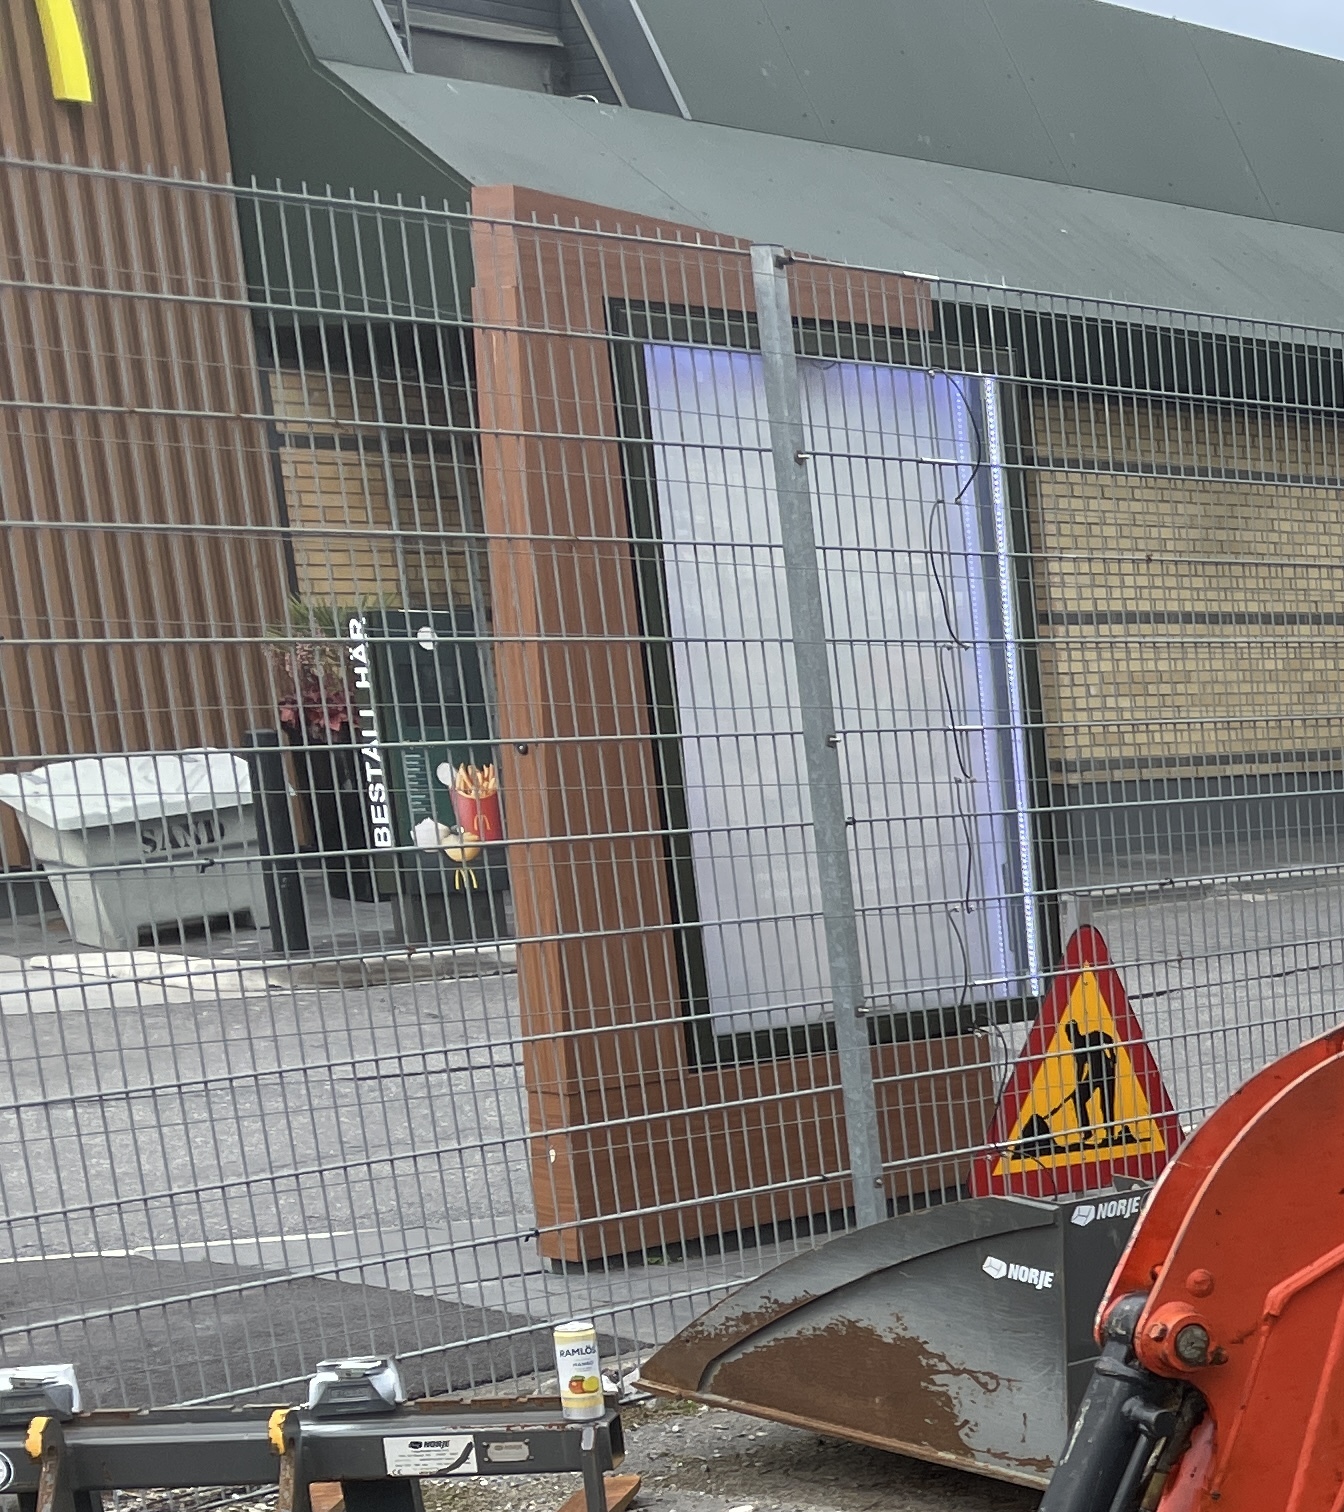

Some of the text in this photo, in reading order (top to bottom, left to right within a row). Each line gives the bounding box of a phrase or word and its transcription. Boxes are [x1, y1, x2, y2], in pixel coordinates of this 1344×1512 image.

[141, 819, 226, 854] SAND
[1096, 1196, 1142, 1220] NORJE
[1007, 1263, 1055, 1290] NORJE
[560, 1345, 597, 1357] RAMLÖS
